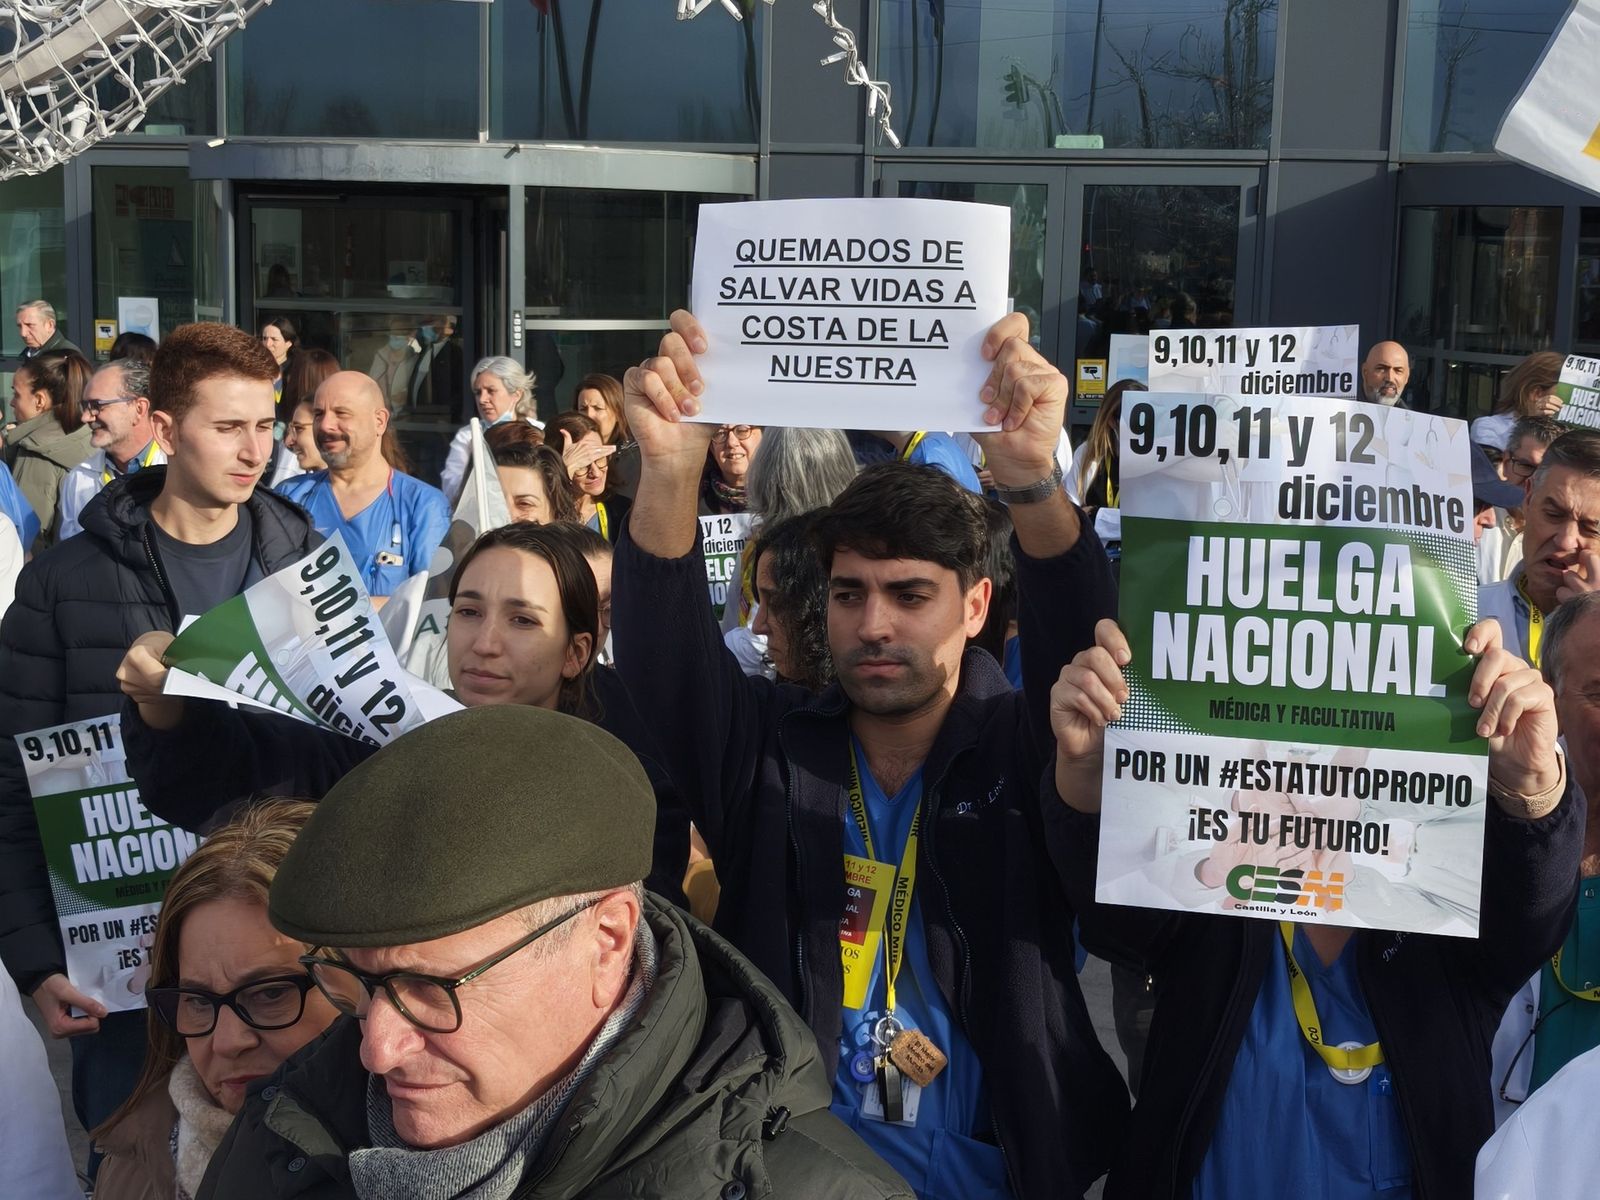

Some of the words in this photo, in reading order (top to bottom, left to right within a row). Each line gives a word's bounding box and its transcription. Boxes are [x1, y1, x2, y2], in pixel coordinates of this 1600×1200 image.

[736, 238, 911, 263] QUEMADOS
[922, 239, 964, 264] DE
[719, 276, 841, 301] SALVAR
[850, 277, 945, 303] VIDAS
[954, 280, 977, 303] A
[741, 315, 847, 341] COSTA
[858, 317, 898, 342] DE
[909, 318, 949, 343] LA
[770, 354, 917, 381] NUESTRA
[1154, 335, 1237, 367] 9,10,11
[1245, 339, 1260, 367] y
[1268, 334, 1297, 363] 12
[1240, 369, 1353, 395] diciembre
[1129, 402, 1272, 465] 9,10,11
[1286, 415, 1315, 467] y
[1329, 411, 1376, 465] 12
[1278, 475, 1465, 534] diciembre
[705, 521, 712, 538] y
[717, 518, 732, 535] 12
[705, 537, 747, 554] diciem
[1185, 535, 1416, 617] HUELGA
[300, 545, 376, 661] 9,10,11
[334, 651, 380, 690] y
[1151, 611, 1447, 697] NACIONAL
[361, 678, 406, 737] 12
[1209, 695, 1272, 722] MÉDICA
[1276, 702, 1286, 723] Y
[1291, 704, 1396, 732] FACULTATIVA
[23, 722, 115, 763] 9,10,11
[1114, 747, 1166, 784] POR
[1175, 752, 1210, 787] UN
[1219, 758, 1473, 808] #ESTATUTOPROPIO
[1188, 808, 1229, 843] ¡ES
[1238, 811, 1270, 845] TU
[1279, 814, 1391, 857] FUTURO!
[70, 826, 207, 884] NACION
[866, 865, 877, 875] 12
[892, 877, 909, 932] MÉDICO
[1226, 863, 1344, 911] CESM
[1234, 903, 1277, 914] Castilla
[1290, 909, 1317, 917] León
[68, 923, 100, 945] POR
[103, 919, 125, 940] UN
[892, 936, 900, 964] MIR
